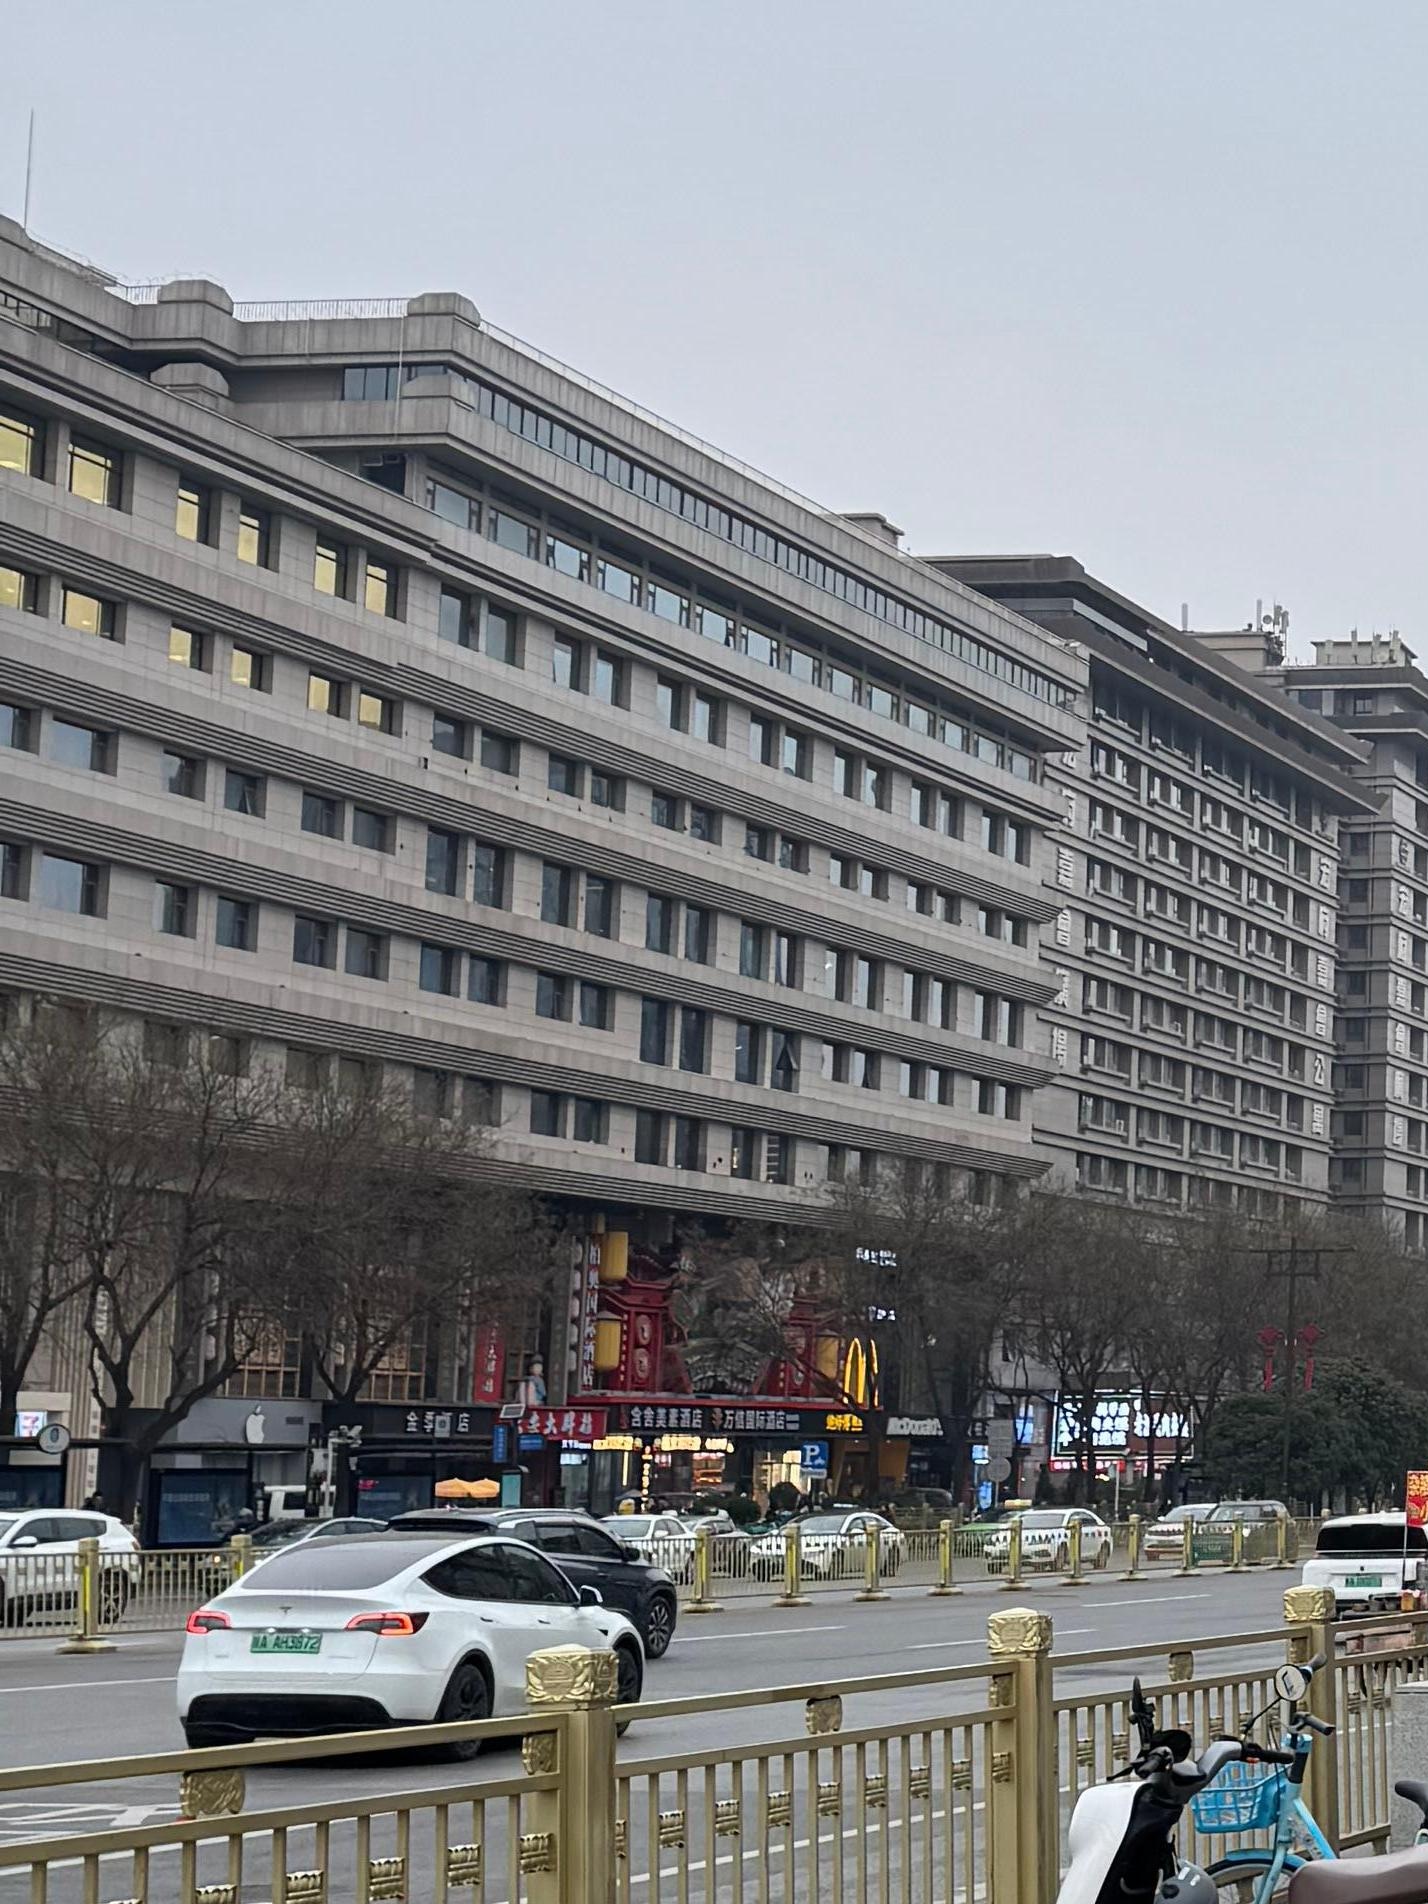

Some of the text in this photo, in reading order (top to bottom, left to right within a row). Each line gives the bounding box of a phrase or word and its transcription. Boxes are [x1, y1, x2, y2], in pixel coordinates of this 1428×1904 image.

[406, 1410, 471, 1433] 全季店
[803, 1444, 821, 1466] P
